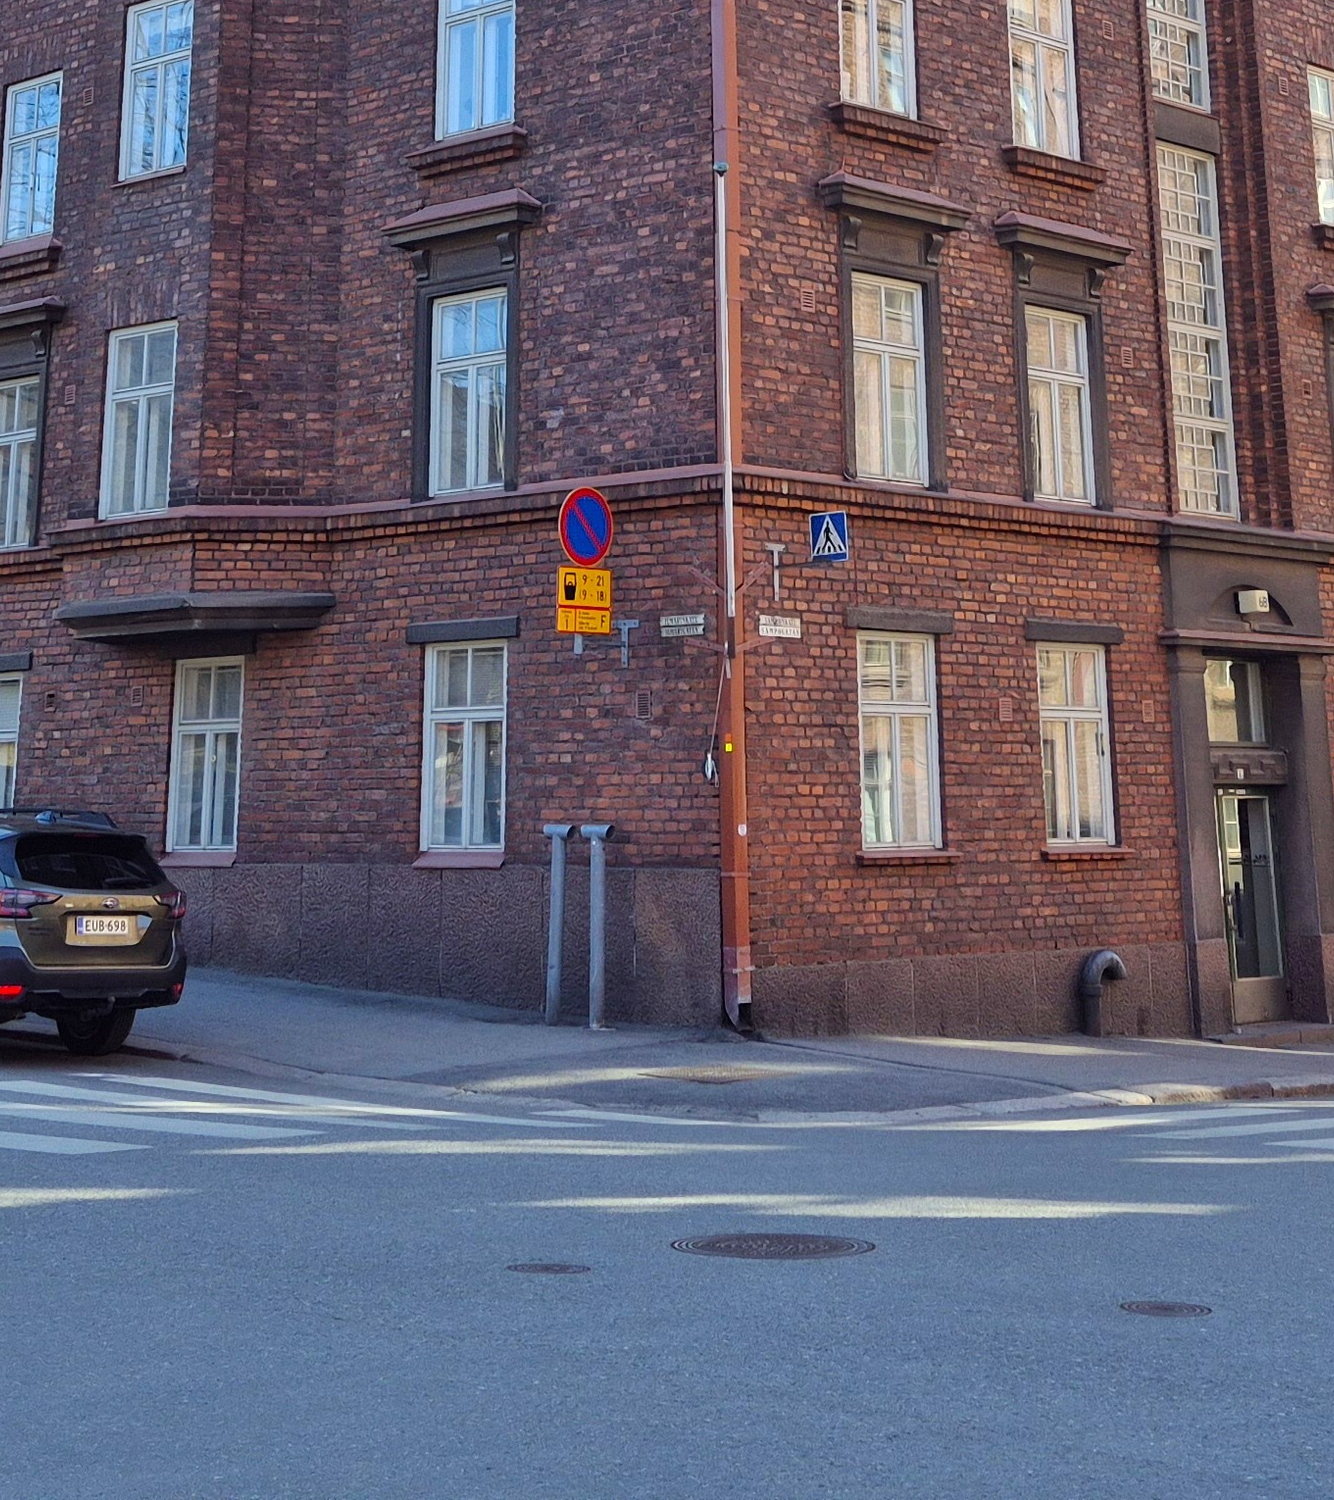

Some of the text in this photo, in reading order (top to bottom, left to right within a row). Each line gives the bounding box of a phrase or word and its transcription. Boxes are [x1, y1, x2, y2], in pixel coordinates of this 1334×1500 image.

[582, 574, 588, 586] 9
[596, 575, 605, 587] 21
[600, 614, 607, 628] F
[85, 919, 126, 932] EUB-698
